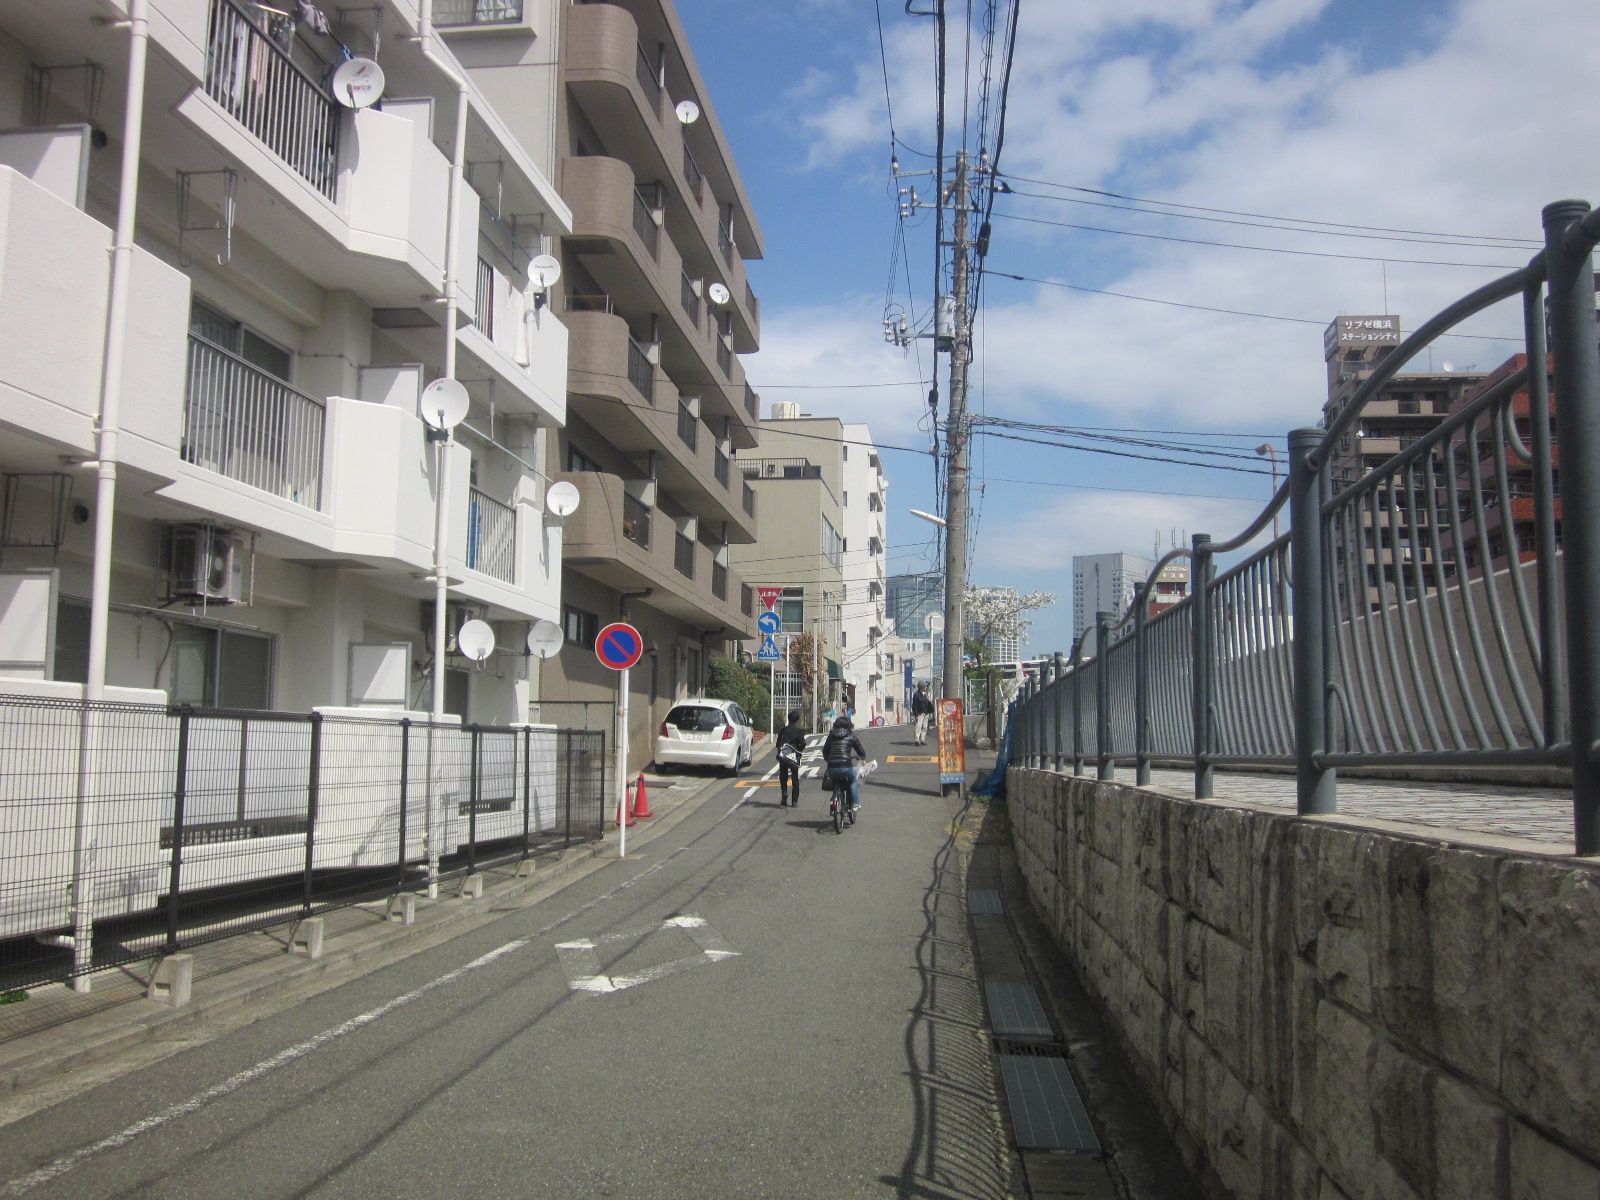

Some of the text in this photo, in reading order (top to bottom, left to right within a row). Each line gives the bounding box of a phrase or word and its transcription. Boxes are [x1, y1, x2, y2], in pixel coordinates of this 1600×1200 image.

[1341, 332, 1398, 341] ステーションシティ
